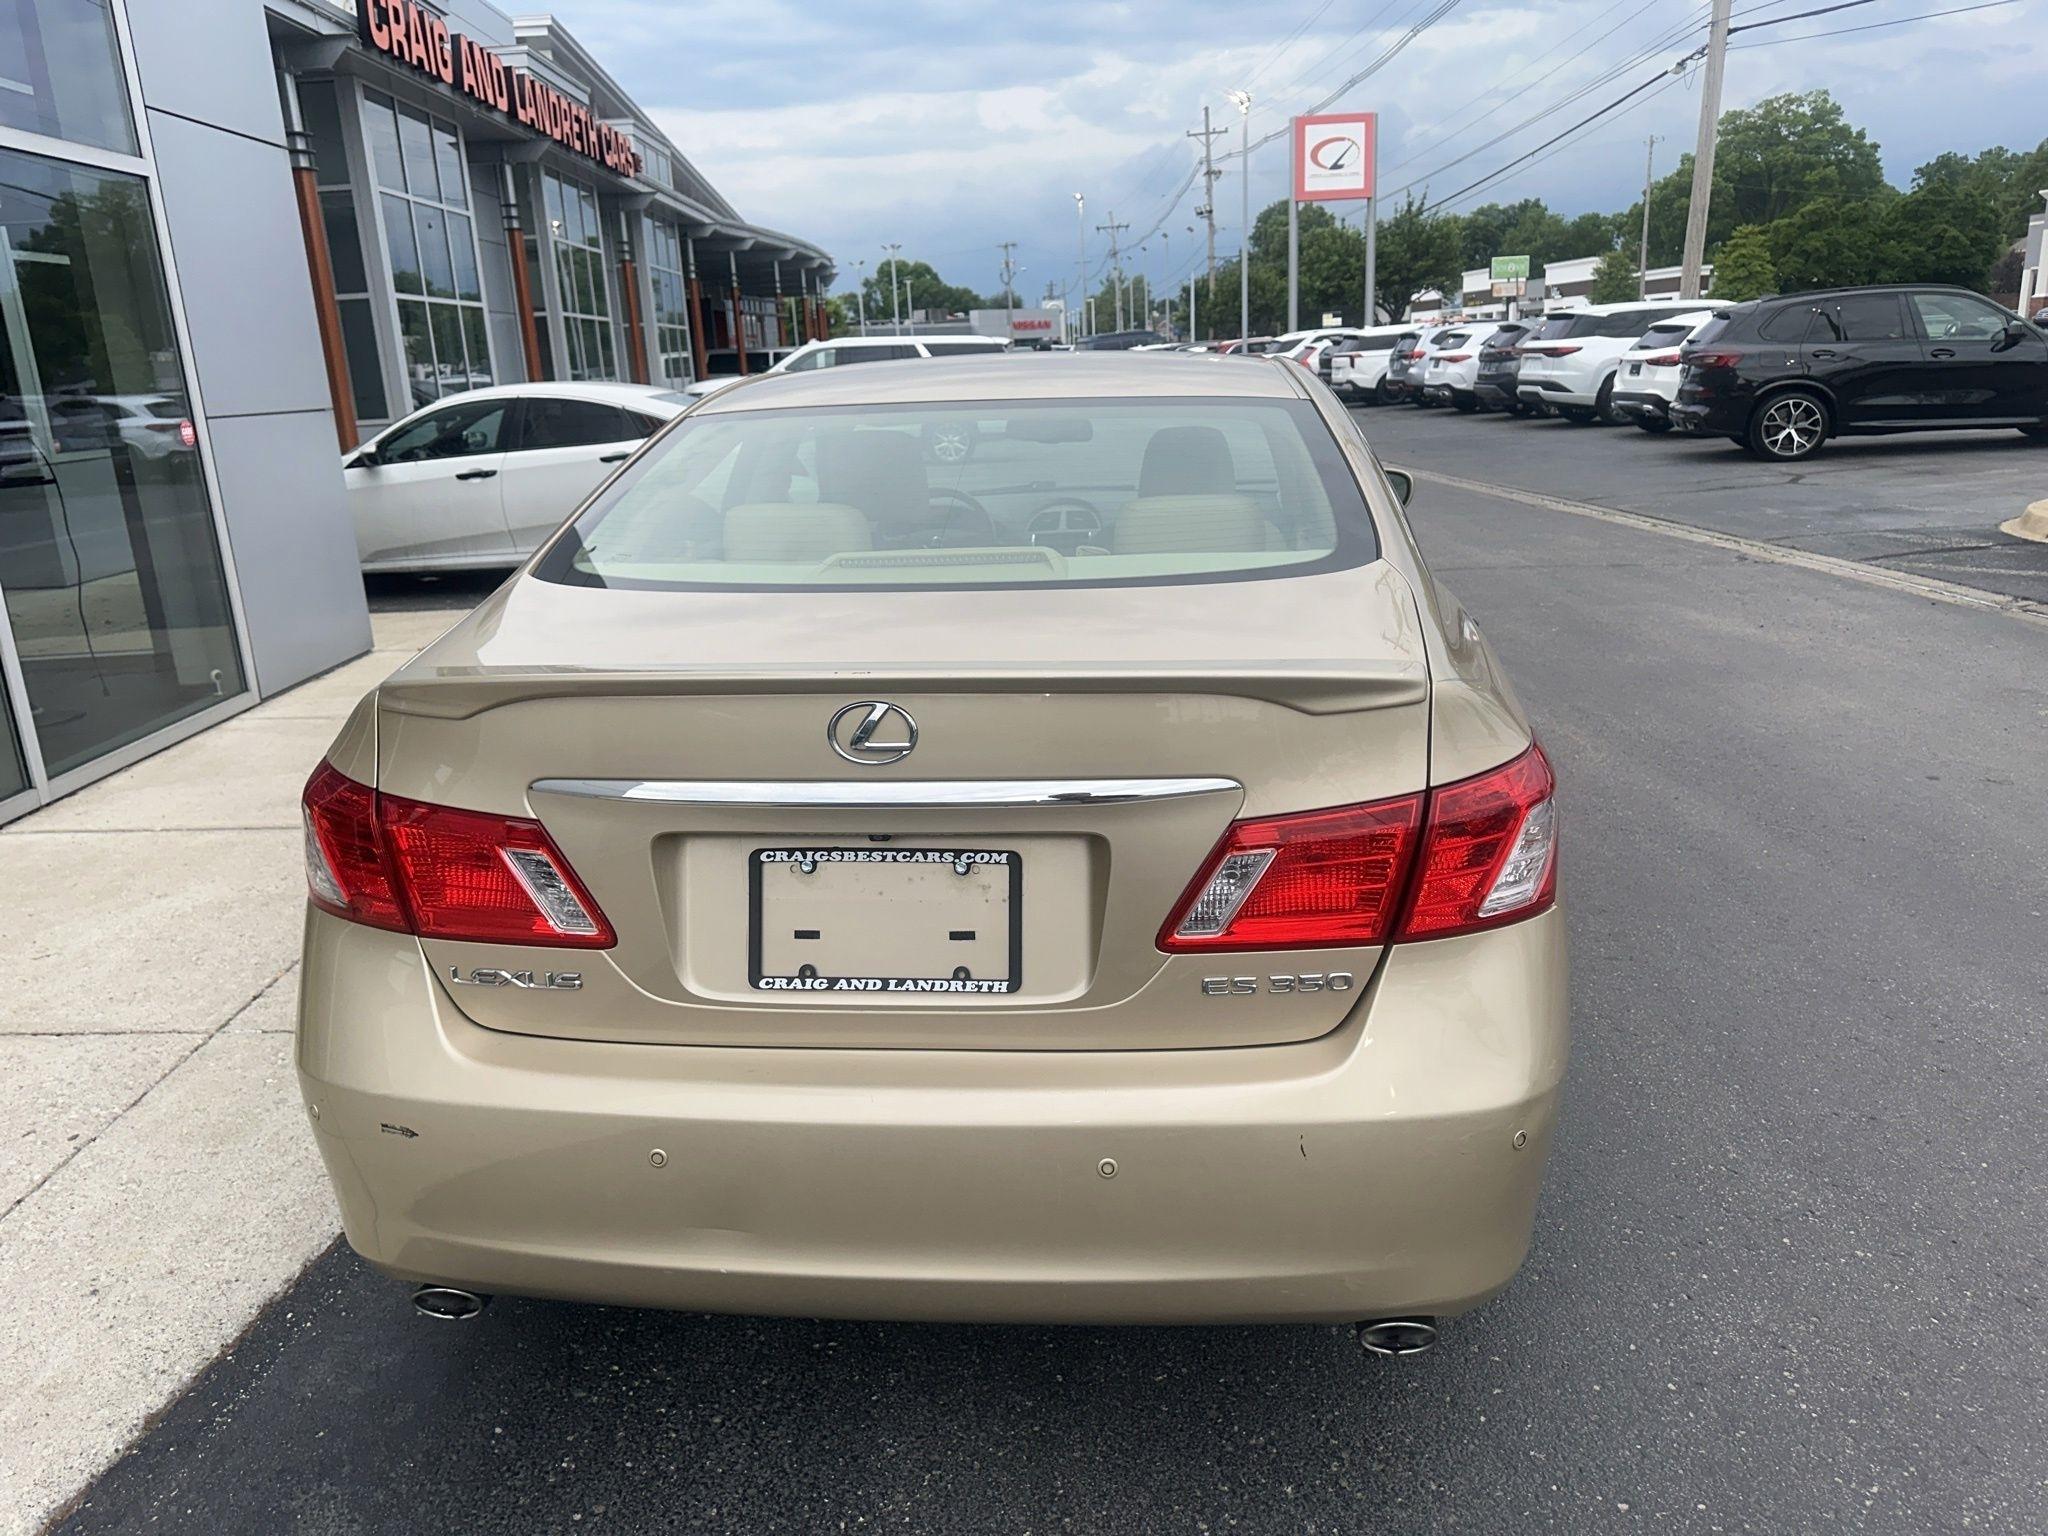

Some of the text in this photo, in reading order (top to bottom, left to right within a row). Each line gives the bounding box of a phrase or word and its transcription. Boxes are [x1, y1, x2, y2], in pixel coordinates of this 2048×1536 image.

[367, 0, 635, 178] CRAIG AND LANDRETH CARS
[1012, 319, 1052, 331] NISSAN
[759, 850, 1009, 864] CRAIGSBESTCARS.COM
[449, 965, 583, 990] LEXUS
[758, 977, 1009, 993] CRAIG AND LANDRETH
[1202, 972, 1354, 996] ES 350
